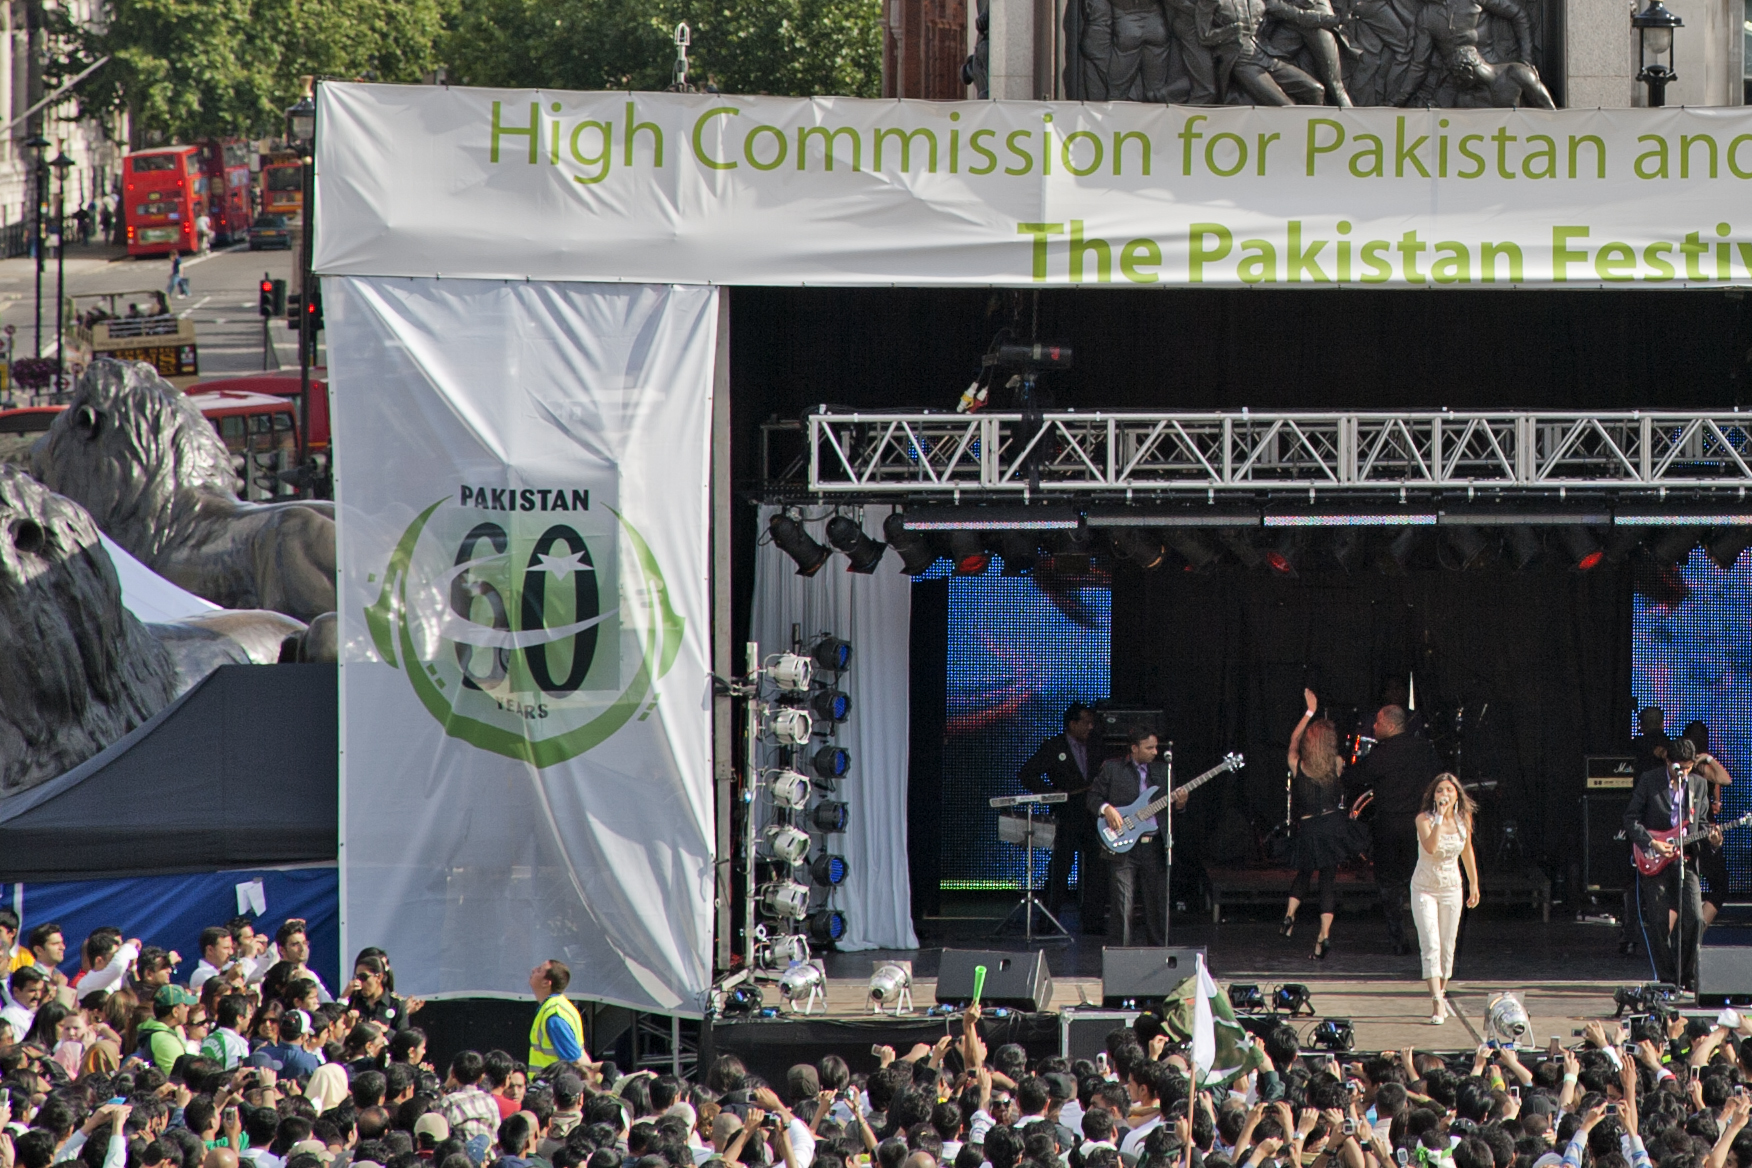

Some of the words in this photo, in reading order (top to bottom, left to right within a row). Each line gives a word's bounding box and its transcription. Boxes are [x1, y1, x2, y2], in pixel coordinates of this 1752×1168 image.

[490, 100, 664, 185] High
[691, 106, 1151, 177] Commission
[1178, 115, 1281, 177] for
[1306, 117, 1606, 180] Pakistan
[1016, 221, 1162, 284] The
[1189, 221, 1523, 284] Pakistan
[461, 485, 589, 512] PAKISTAN
[451, 522, 600, 699] 60
[496, 696, 548, 719] YEARS
